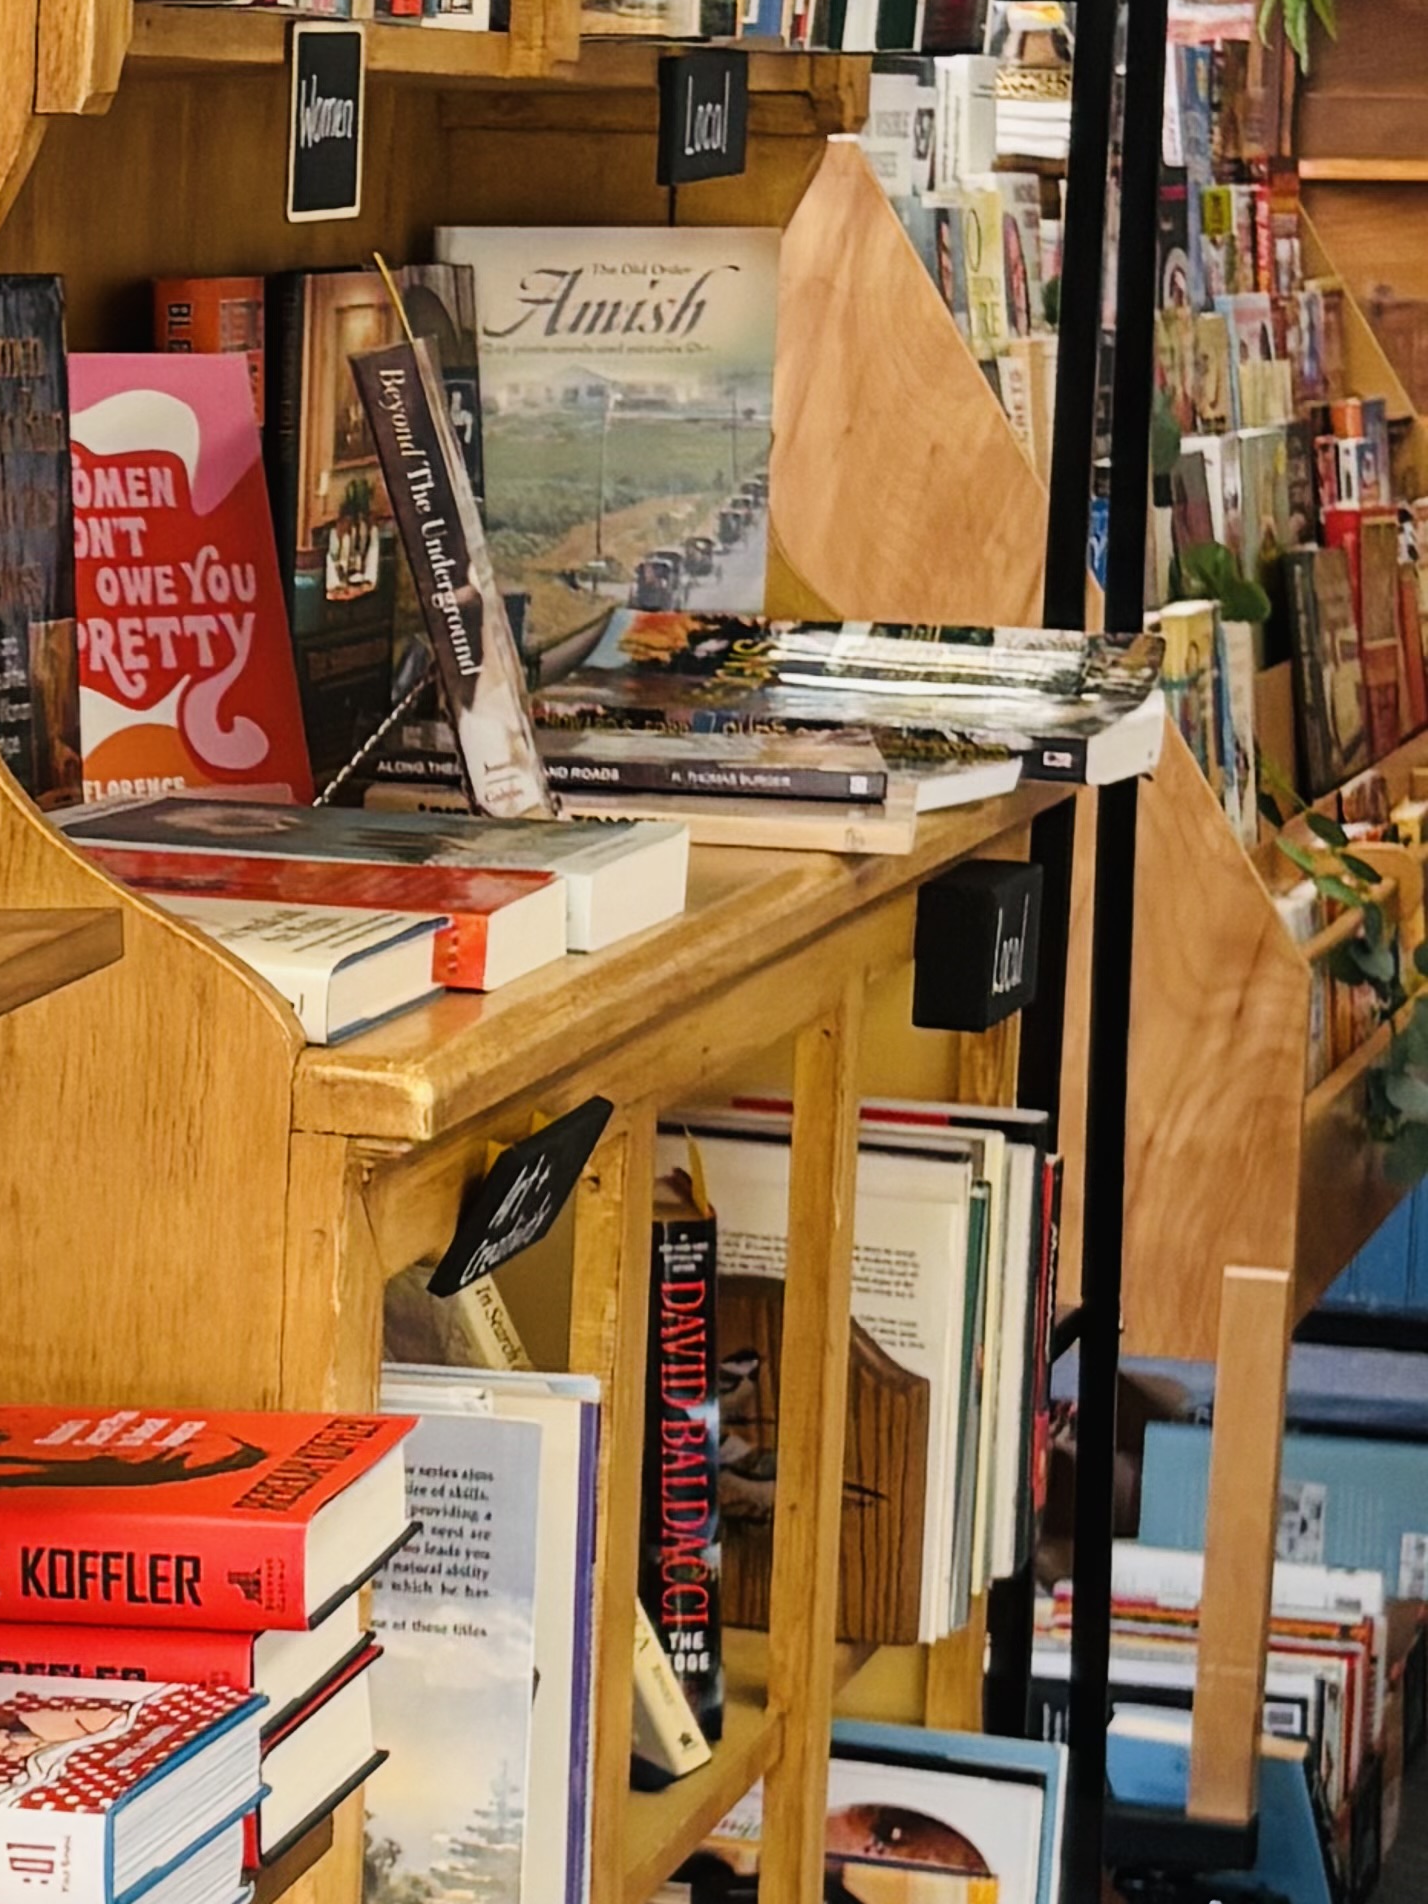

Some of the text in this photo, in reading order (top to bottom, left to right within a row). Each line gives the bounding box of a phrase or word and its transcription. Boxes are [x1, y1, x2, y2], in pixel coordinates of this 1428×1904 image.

[301, 74, 353, 148] Women
[483, 264, 741, 339] Amish
[380, 368, 483, 677] Beyond The Underground
[96, 544, 257, 606] OWE YOU
[476, 1285, 524, 1366] In Search
[661, 1280, 707, 1410] DAVID
[410, 1505, 480, 1523] providing
[661, 1418, 710, 1626] BALDACCI
[19, 1546, 203, 1607] KOFFLER
[669, 1630, 705, 1651] THE
